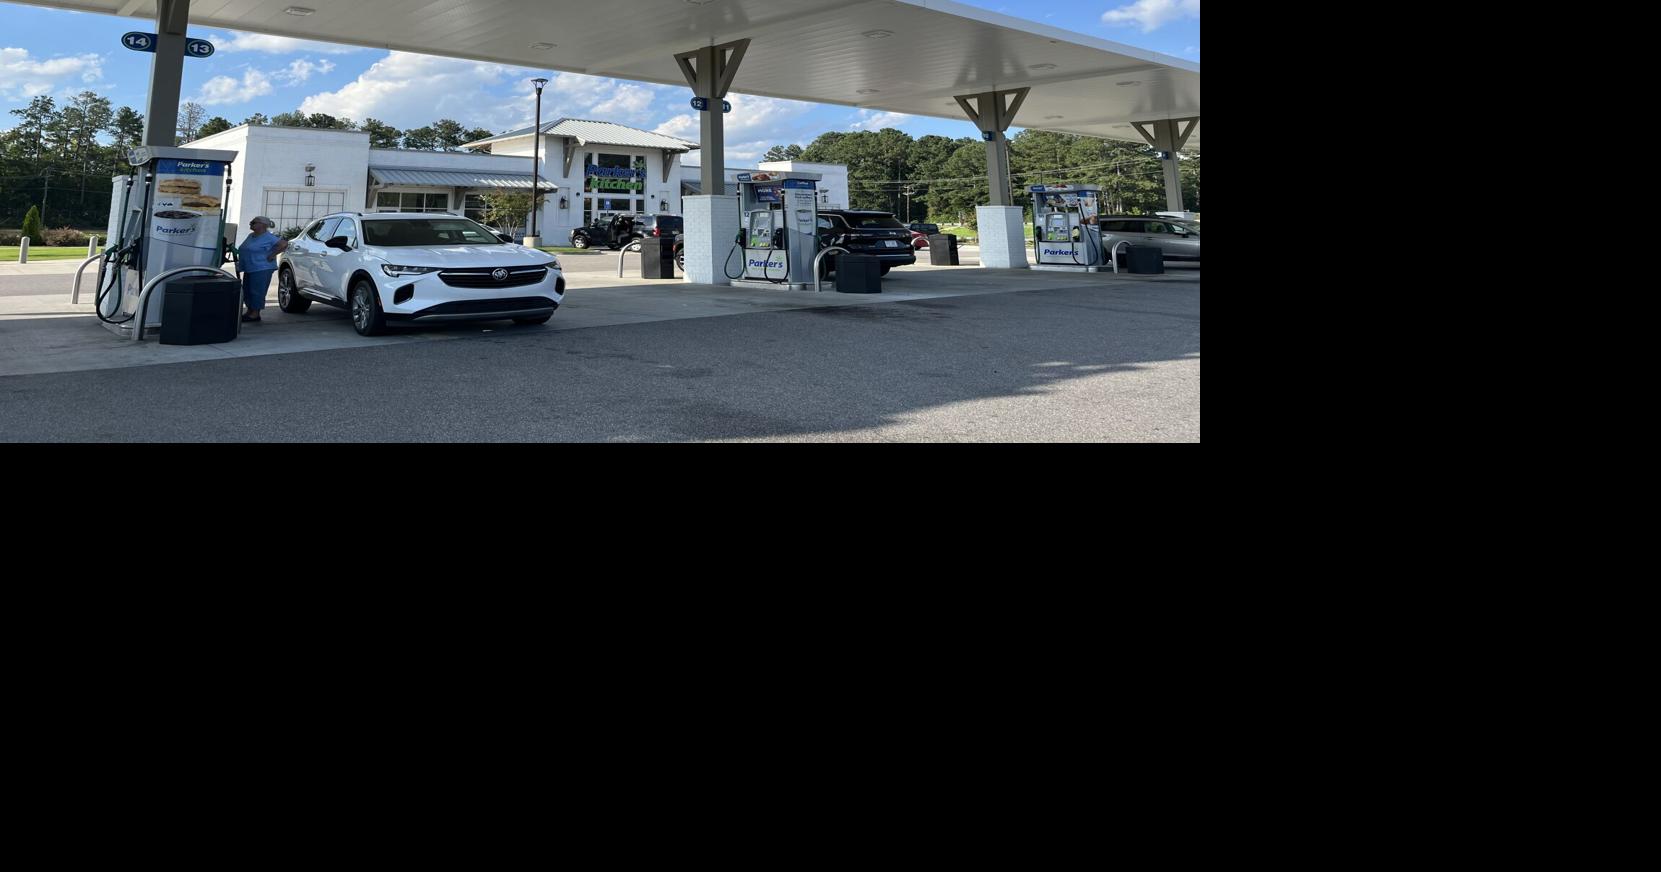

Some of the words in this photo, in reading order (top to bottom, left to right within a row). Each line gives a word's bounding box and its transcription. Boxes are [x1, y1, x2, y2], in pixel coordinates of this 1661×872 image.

[126, 36, 147, 46] 14
[191, 43, 210, 53] 13
[177, 161, 209, 169] Parker's
[586, 164, 647, 179] Parker's
[590, 176, 643, 191] kitchen
[156, 224, 196, 235] Parker's
